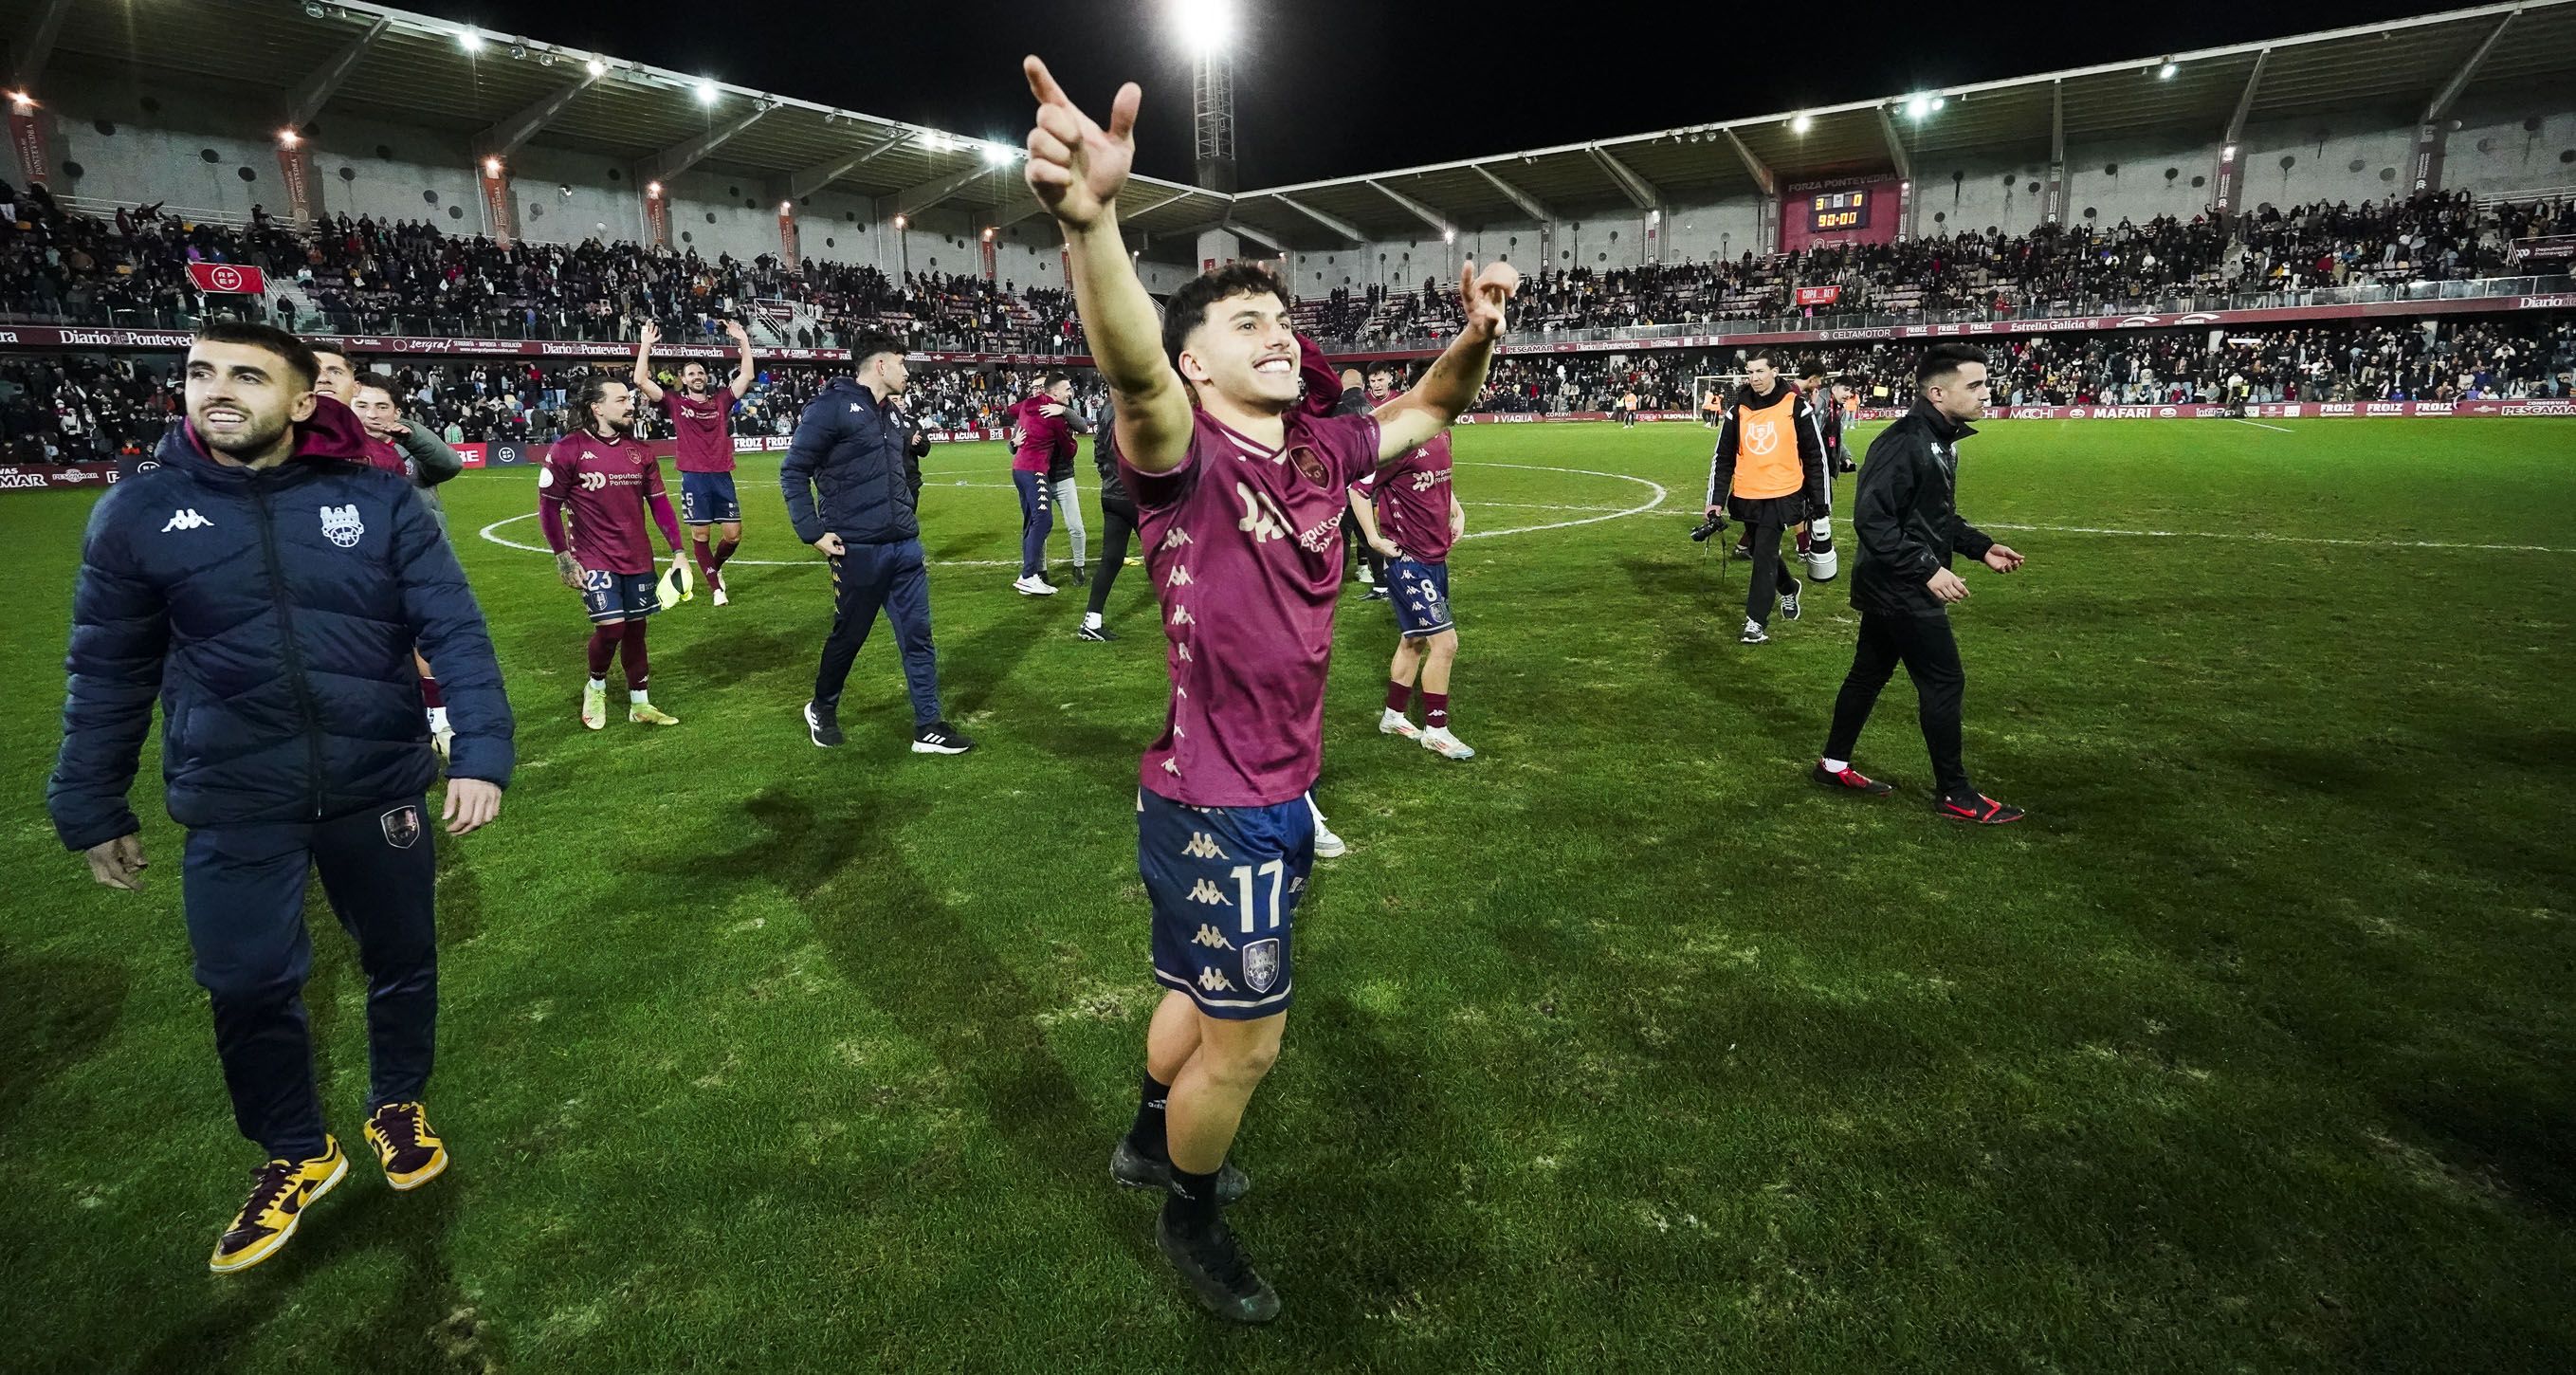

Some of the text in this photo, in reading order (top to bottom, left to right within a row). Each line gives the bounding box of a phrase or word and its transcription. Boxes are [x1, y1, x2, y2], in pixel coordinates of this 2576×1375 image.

[1788, 173, 1897, 192] FORZA PONTEVEDRA
[1815, 193, 1863, 211] 3 0
[1833, 329, 1891, 339] CELTAMOTOR
[2320, 404, 2355, 412] FROIZ
[2366, 403, 2403, 412] FROIZ
[2416, 402, 2453, 412] FROIZ
[2092, 408, 2152, 419] MAFARI
[734, 437, 763, 448] FROIZ
[766, 436, 794, 447] FROIZ
[685, 492, 694, 506] 5
[587, 569, 612, 591] 23
[1420, 578, 1437, 602] 8
[1230, 858, 1285, 933] 17
